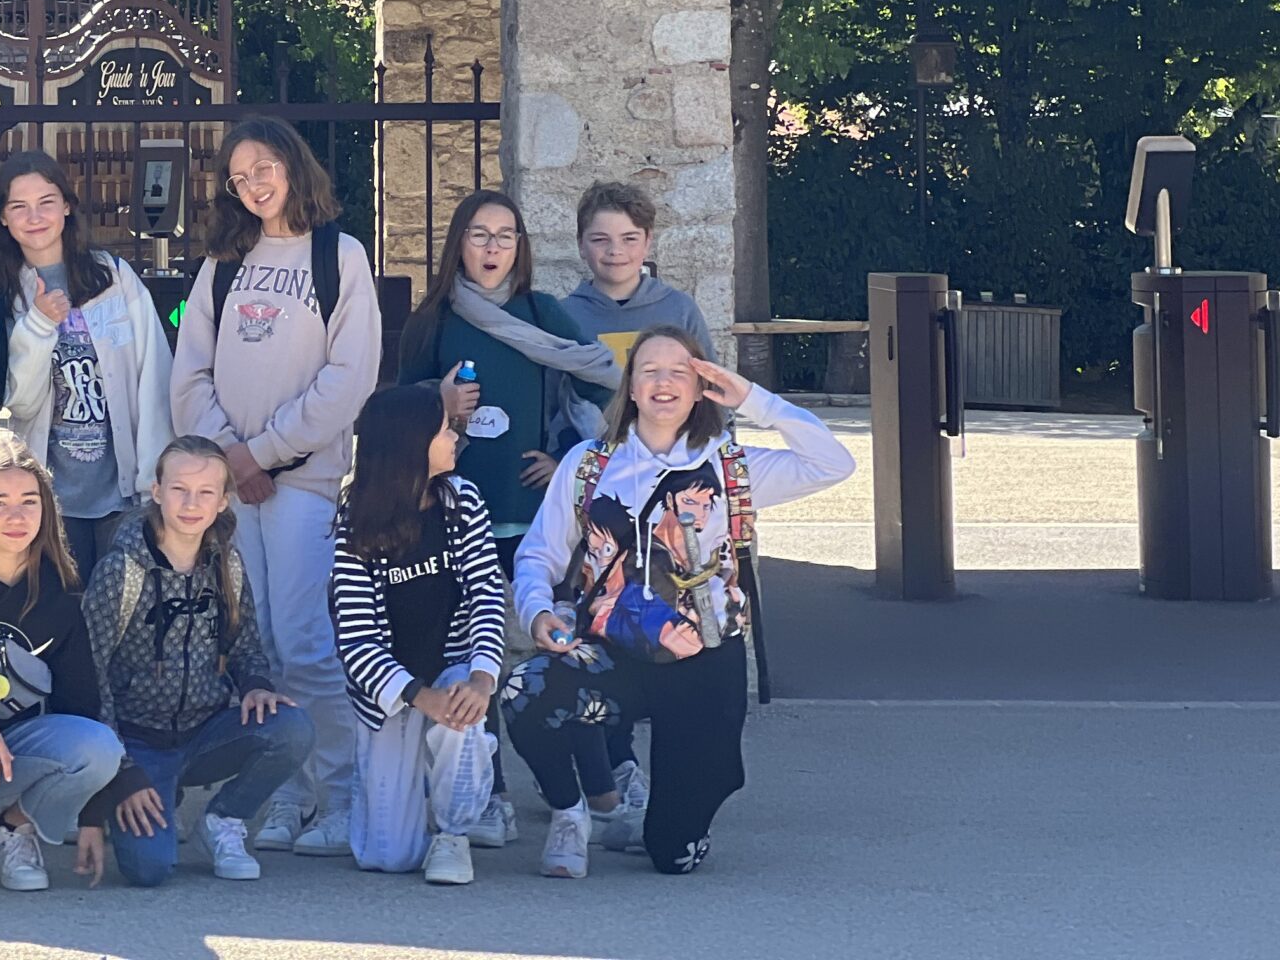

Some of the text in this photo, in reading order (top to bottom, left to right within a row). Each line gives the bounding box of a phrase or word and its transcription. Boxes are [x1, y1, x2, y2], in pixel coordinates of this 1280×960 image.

[99, 61, 133, 98] Guide
[229, 264, 318, 316] RIZONA
[388, 556, 439, 584] BILLIE
